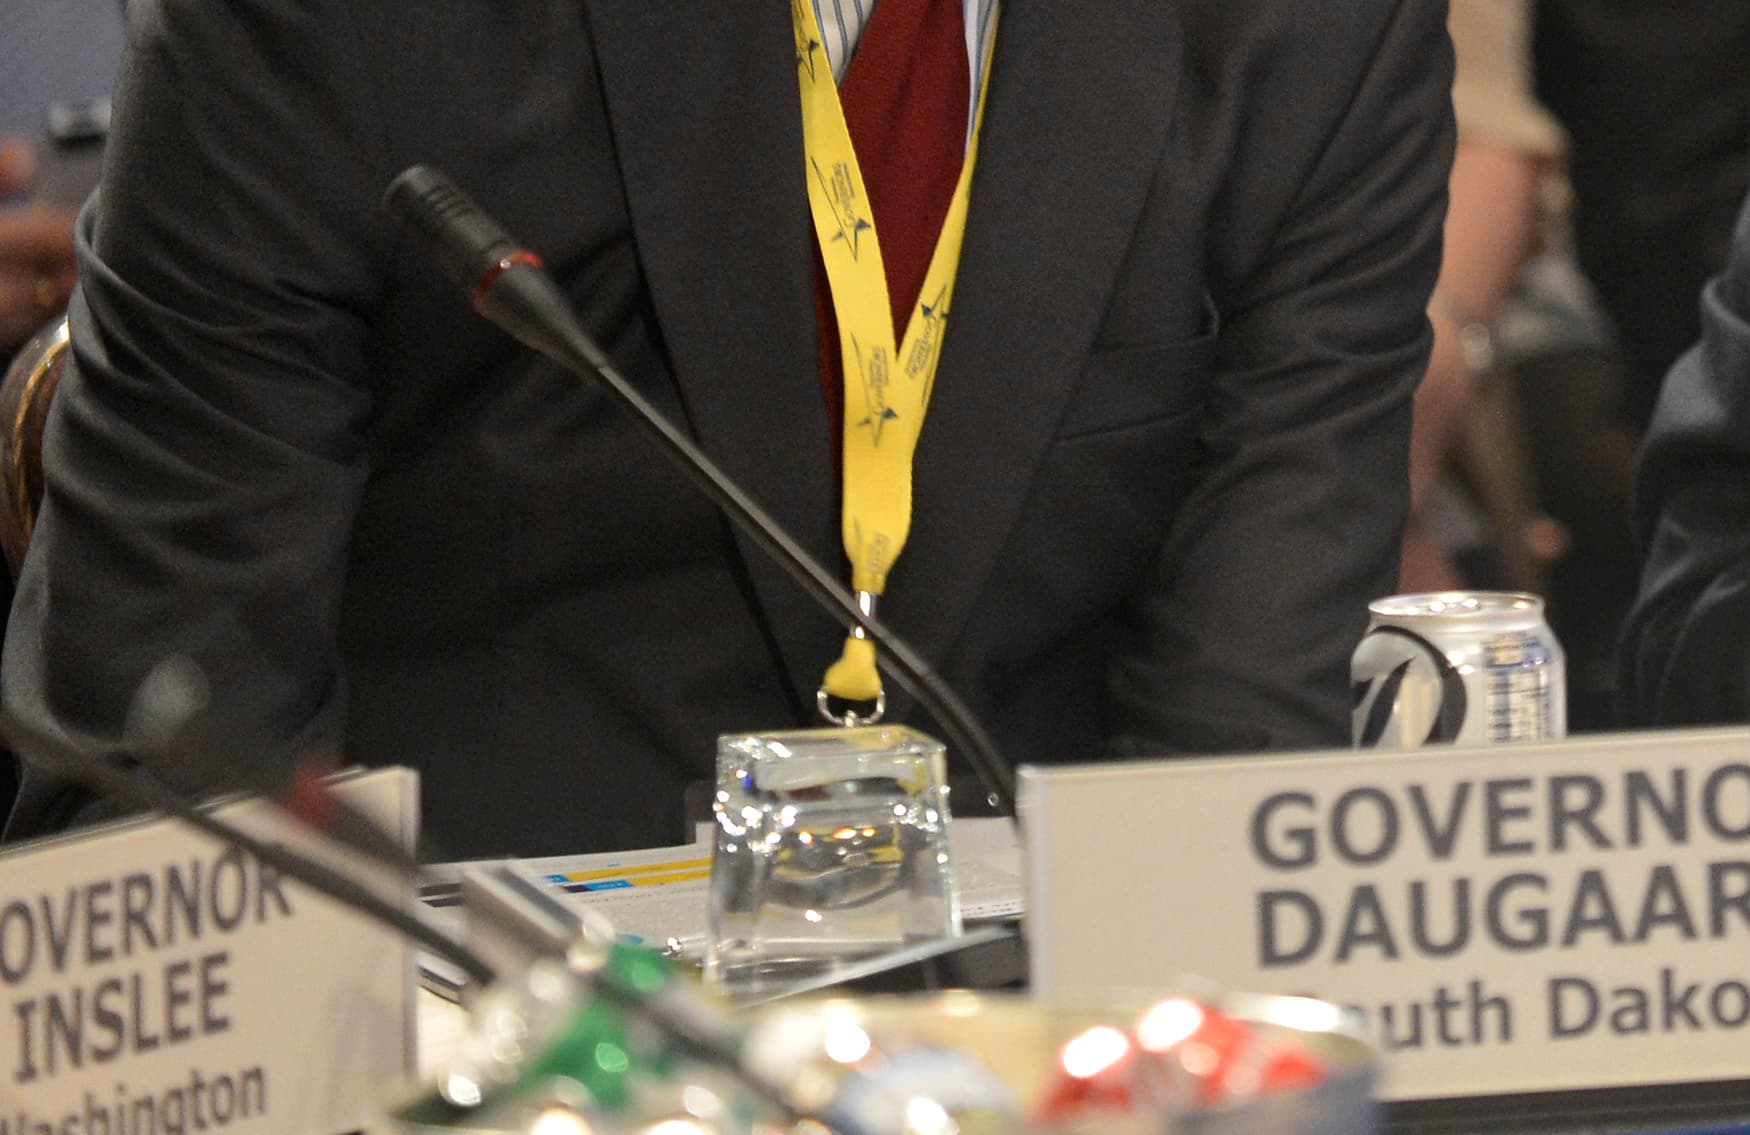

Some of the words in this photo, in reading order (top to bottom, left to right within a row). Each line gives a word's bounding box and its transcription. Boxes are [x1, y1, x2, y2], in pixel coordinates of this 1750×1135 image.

[13, 951, 231, 1083] INSLEE
[1345, 978, 1515, 1053] uth
[0, 1066, 266, 1135] hington
